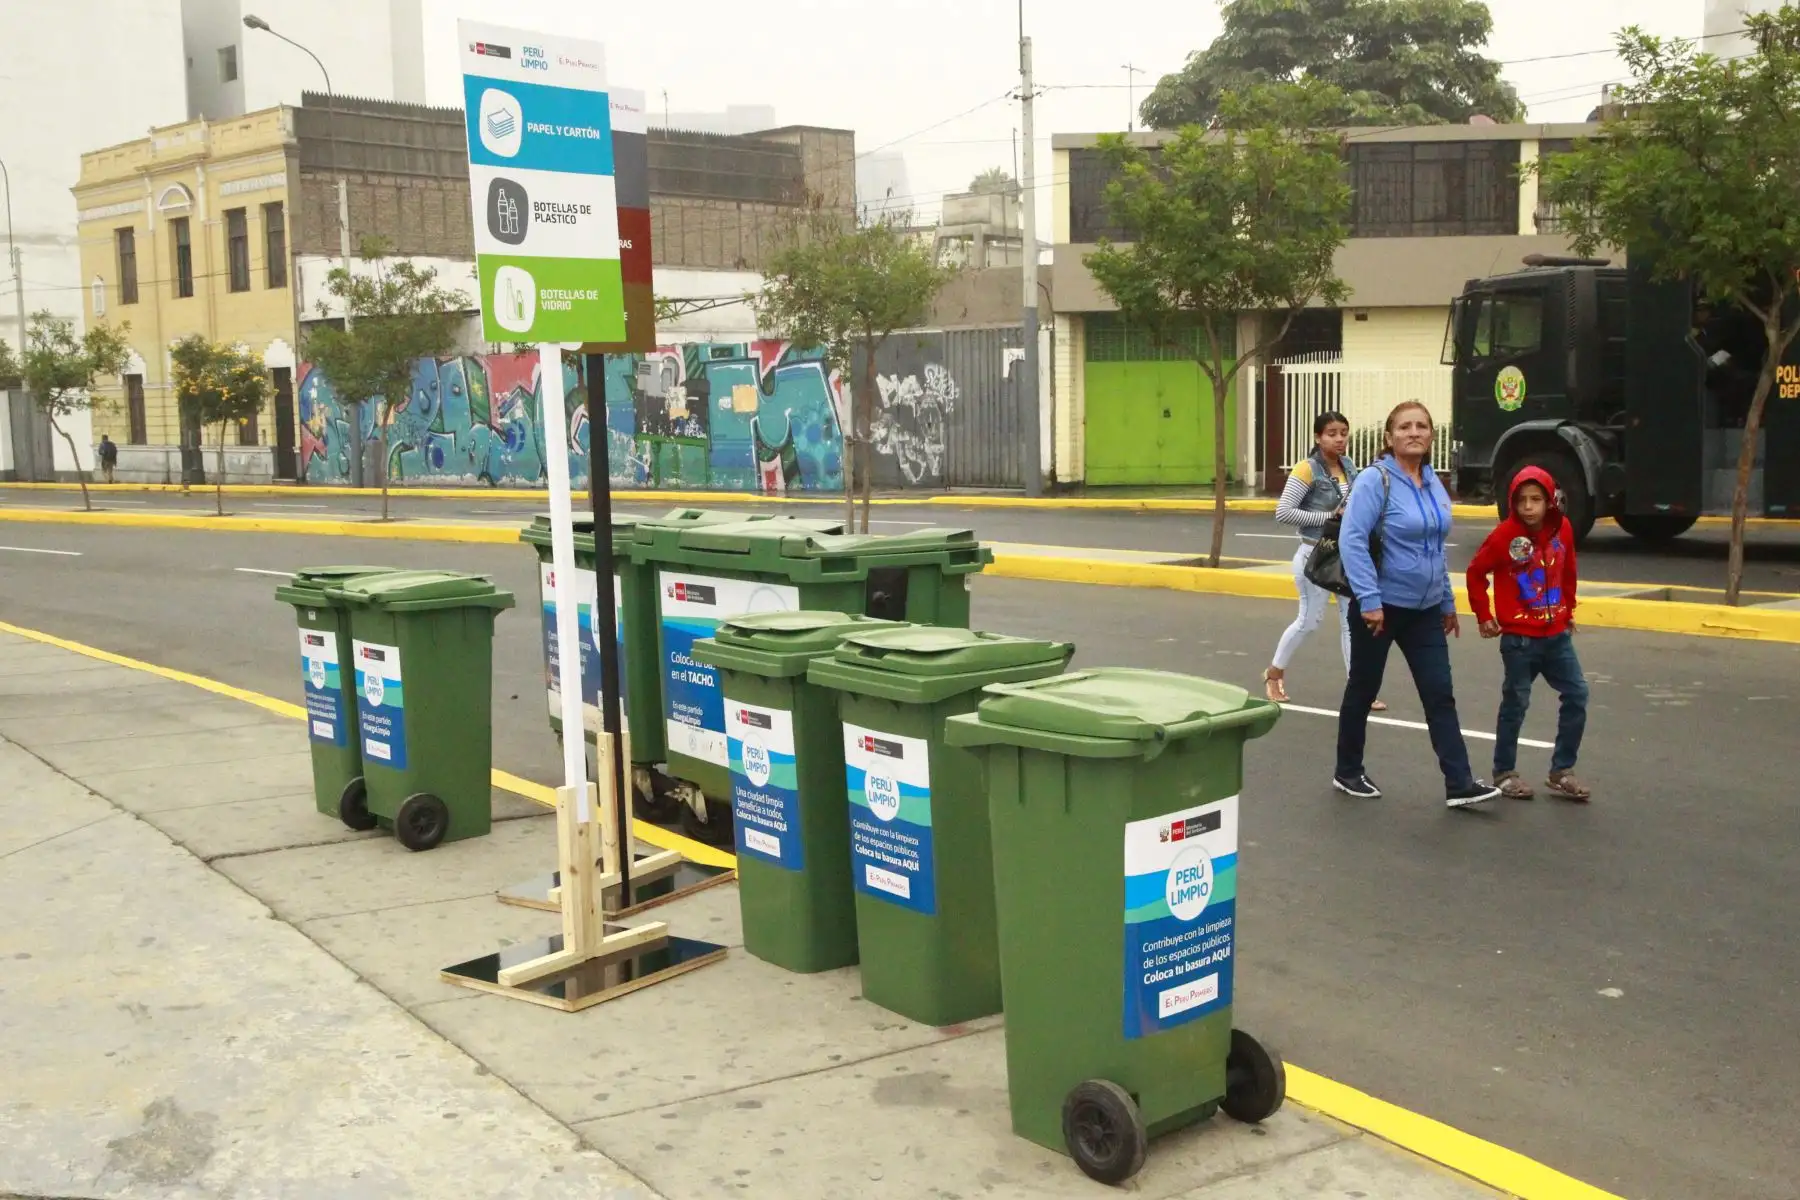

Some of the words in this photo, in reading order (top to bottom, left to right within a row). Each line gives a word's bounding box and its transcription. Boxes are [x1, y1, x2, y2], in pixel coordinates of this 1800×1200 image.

[523, 45, 544, 59] PERÚ
[521, 57, 548, 71] LIMPIO
[527, 122, 556, 135] PAPEL
[556, 125, 563, 136] Y
[563, 126, 600, 140] CARTÓN
[533, 201, 578, 214] BOTELLAS
[580, 204, 592, 215] DE
[534, 212, 577, 225] PLASTICO
[540, 289, 585, 300] BOTELLAS
[586, 290, 599, 301] DE
[541, 300, 572, 311] VIDRIO
[671, 670, 680, 680] en
[680, 669, 688, 682] el
[688, 671, 715, 688] TACHO.
[746, 745, 764, 761] PERÚ
[745, 760, 768, 775] LIMPIO
[870, 775, 892, 793] PERÚ
[735, 785, 747, 798] Una
[747, 790, 765, 803] ciudad
[765, 794, 784, 809] limpia
[737, 797, 762, 813] beneficia
[868, 789, 897, 808] LIMPIO
[736, 808, 752, 821] Coloca
[752, 814, 758, 823] tu
[757, 815, 774, 828] basura
[773, 820, 788, 833] AQUÍ
[853, 819, 880, 836] Contribuye
[879, 828, 890, 838] con
[889, 829, 896, 839] la
[895, 831, 919, 846] limpieza
[854, 831, 861, 840] de
[861, 833, 870, 844] los
[869, 837, 894, 851] espacios
[855, 843, 875, 858] Coloca
[874, 850, 882, 860] tu
[881, 851, 902, 866] basura
[902, 858, 920, 872] AQUÍ
[1175, 859, 1205, 886] PERÚ
[1171, 882, 1209, 906] LIMPIO
[1142, 936, 1184, 953] Contribuye
[1184, 930, 1197, 941] con
[1197, 927, 1205, 937] la
[1205, 917, 1232, 935] limpieza
[1143, 957, 1154, 969] de
[1155, 954, 1168, 966] los
[1168, 943, 1201, 963] espacios
[1143, 967, 1174, 985] Coloca
[1175, 965, 1184, 976] tu
[1185, 955, 1211, 972] basura
[1211, 942, 1231, 963] AQUÍ
